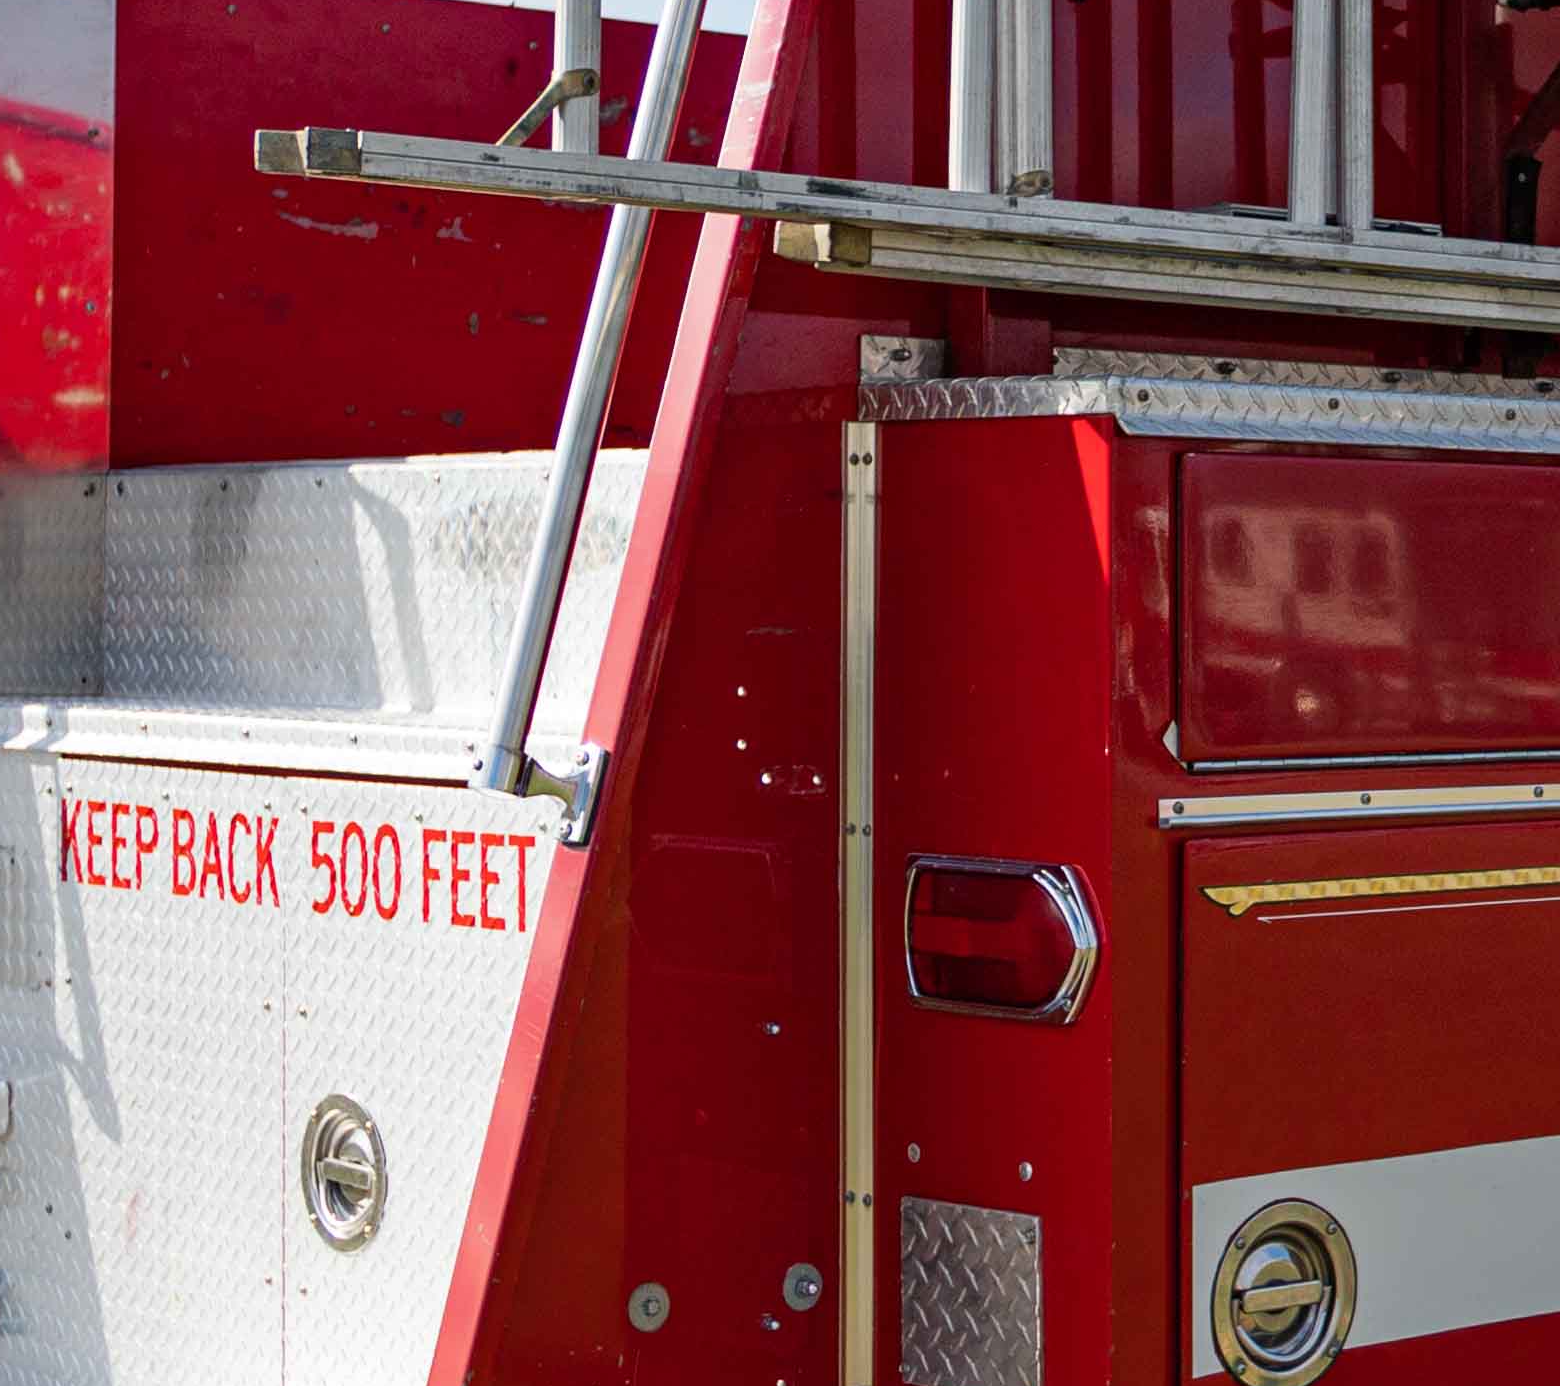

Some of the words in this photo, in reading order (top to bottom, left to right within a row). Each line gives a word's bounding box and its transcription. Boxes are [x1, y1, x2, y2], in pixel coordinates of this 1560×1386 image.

[60, 797, 159, 891] KEEP
[172, 808, 280, 908] BACK
[311, 820, 401, 920] 500
[422, 829, 536, 932] FEET
